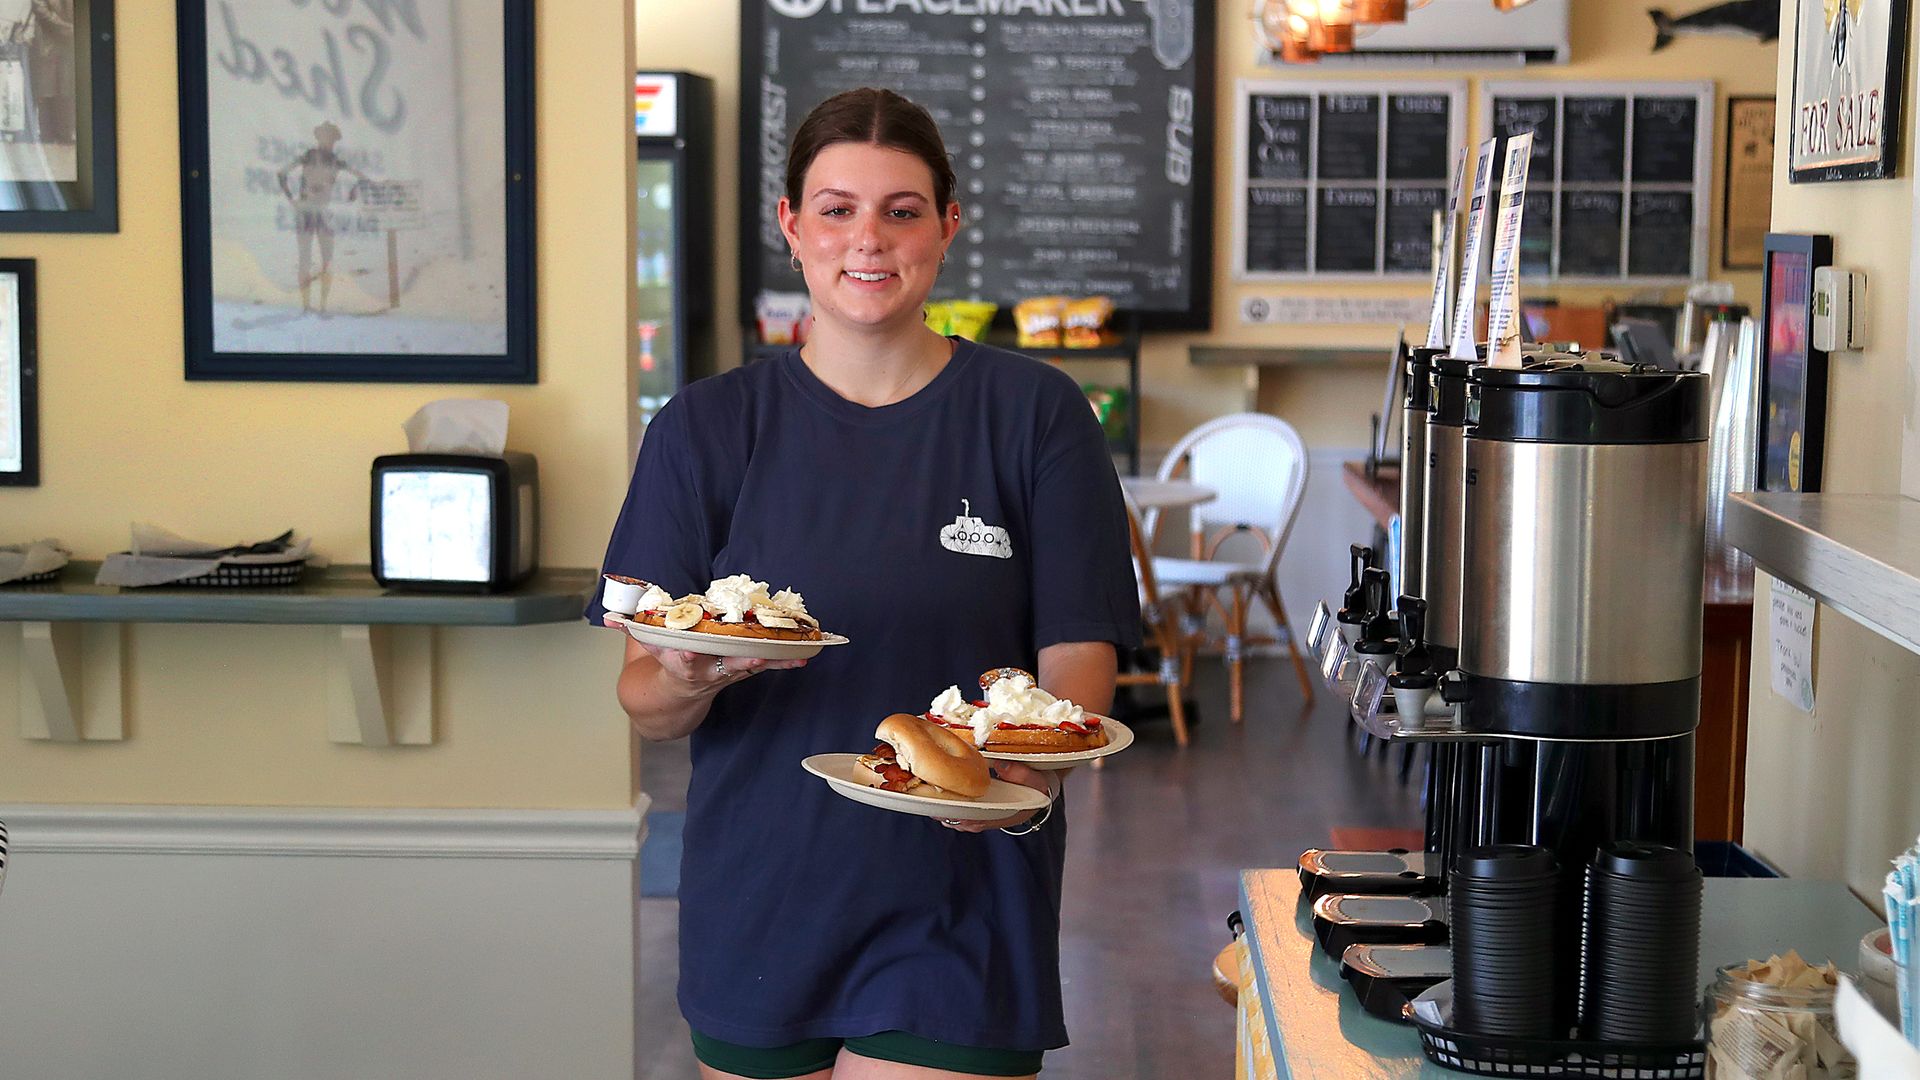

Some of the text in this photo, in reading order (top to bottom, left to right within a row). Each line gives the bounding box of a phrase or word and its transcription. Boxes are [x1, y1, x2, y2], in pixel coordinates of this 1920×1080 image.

[1165, 84, 1194, 186] SUB
[1800, 100, 1829, 156] FOR
[1835, 89, 1879, 152] SALE
